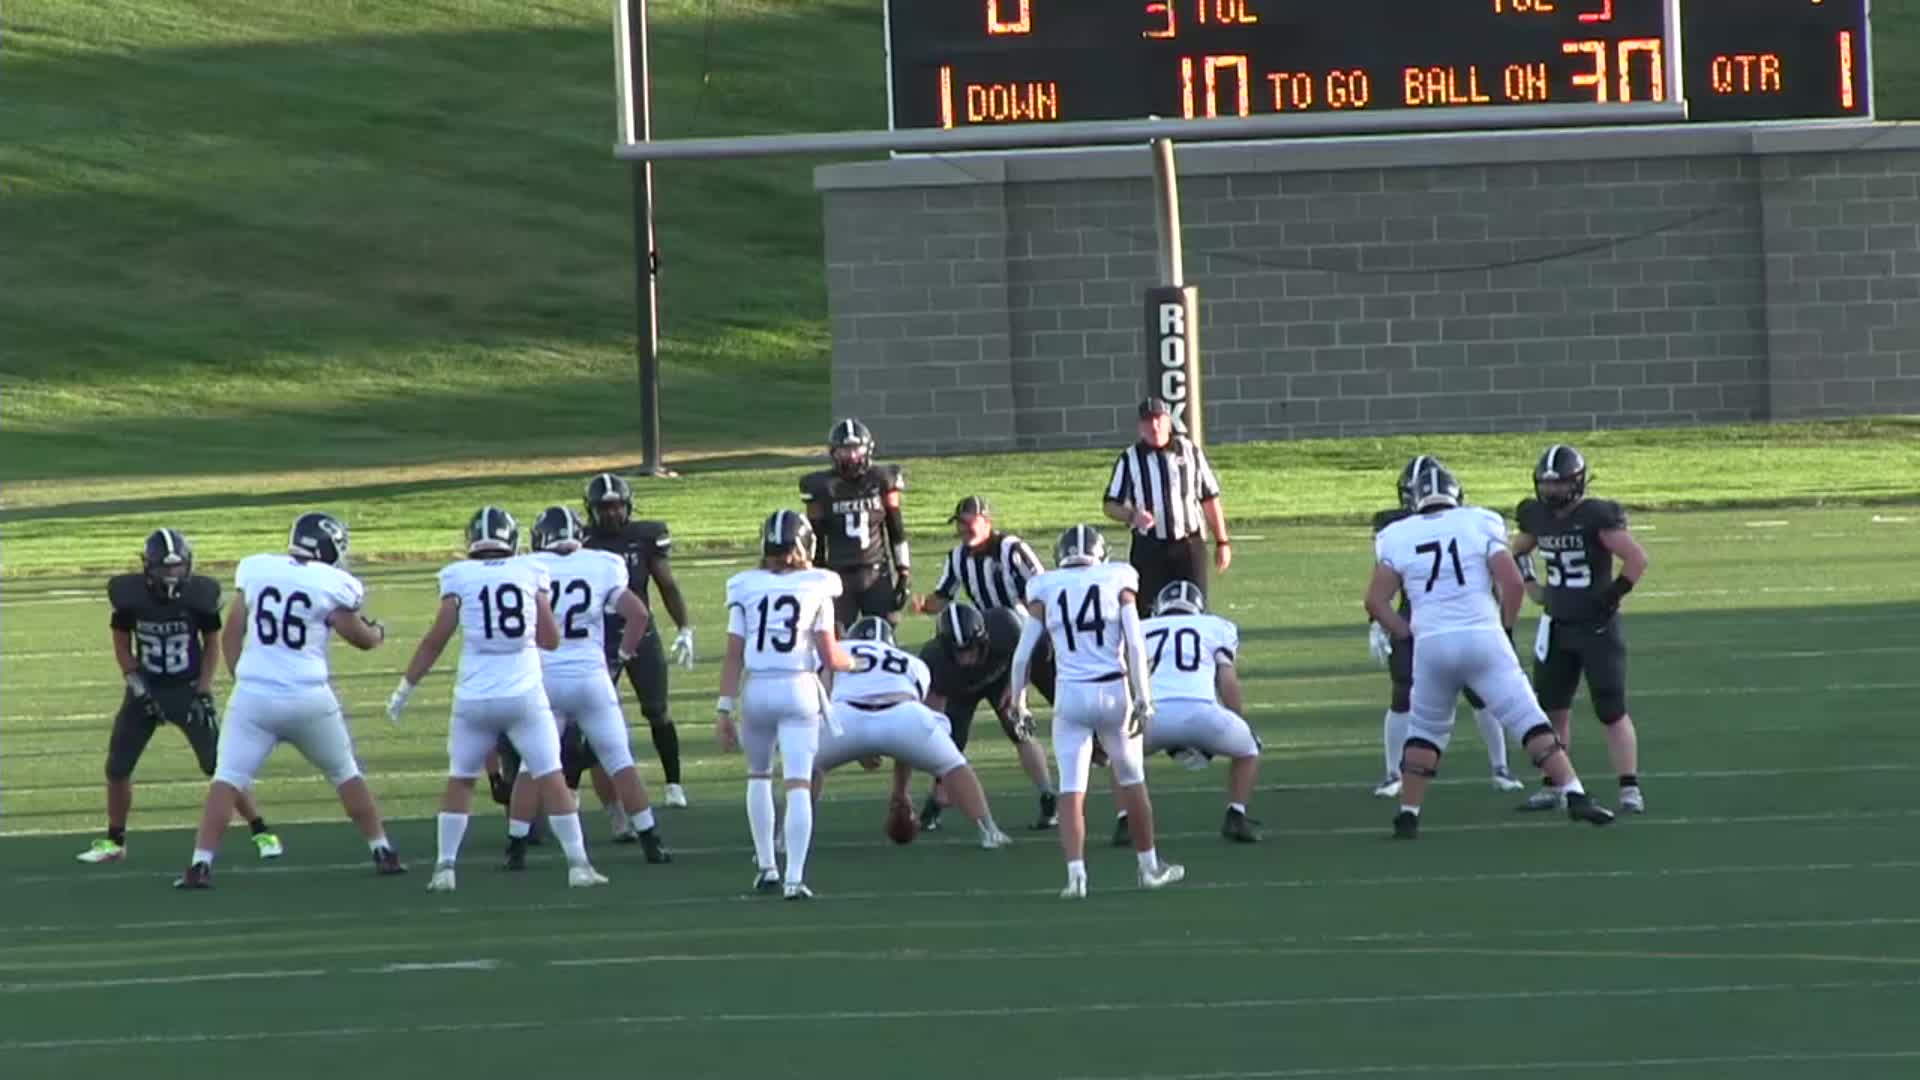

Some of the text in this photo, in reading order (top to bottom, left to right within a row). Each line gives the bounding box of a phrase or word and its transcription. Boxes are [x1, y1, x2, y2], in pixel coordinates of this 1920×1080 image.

[939, 65, 1057, 130] 1 DOWN
[1181, 55, 1368, 120] 10 TO GO
[1404, 39, 1662, 105] BALL ON 30
[1711, 30, 1854, 108] QTR 1
[1159, 303, 1188, 433] ROCK
[845, 512, 871, 550] 4
[1416, 538, 1466, 592] 71
[255, 586, 312, 650] 66
[478, 584, 525, 639] 18
[757, 595, 800, 653] 13
[1057, 584, 1105, 651] 14
[138, 632, 190, 673] 28
[1145, 627, 1201, 675] 70
